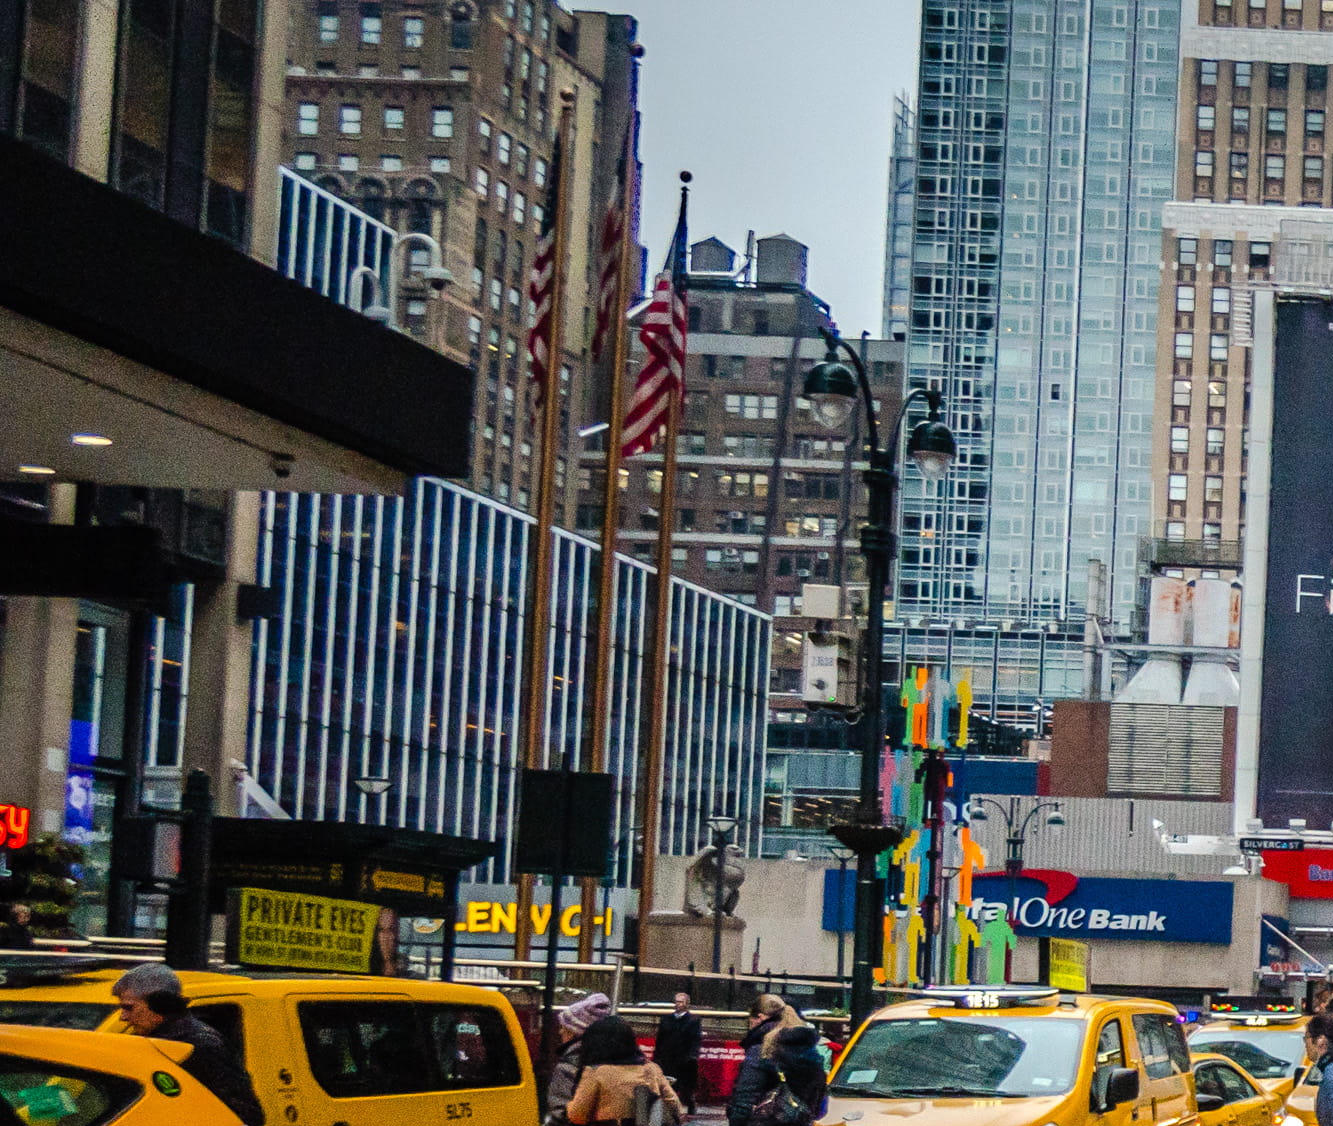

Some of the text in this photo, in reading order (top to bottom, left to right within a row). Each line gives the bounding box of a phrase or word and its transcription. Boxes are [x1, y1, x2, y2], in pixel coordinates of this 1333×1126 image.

[247, 896, 366, 933] PRIVATE EYES
[1088, 909, 1166, 931] Bank
[966, 994, 1000, 1009] 1E15
